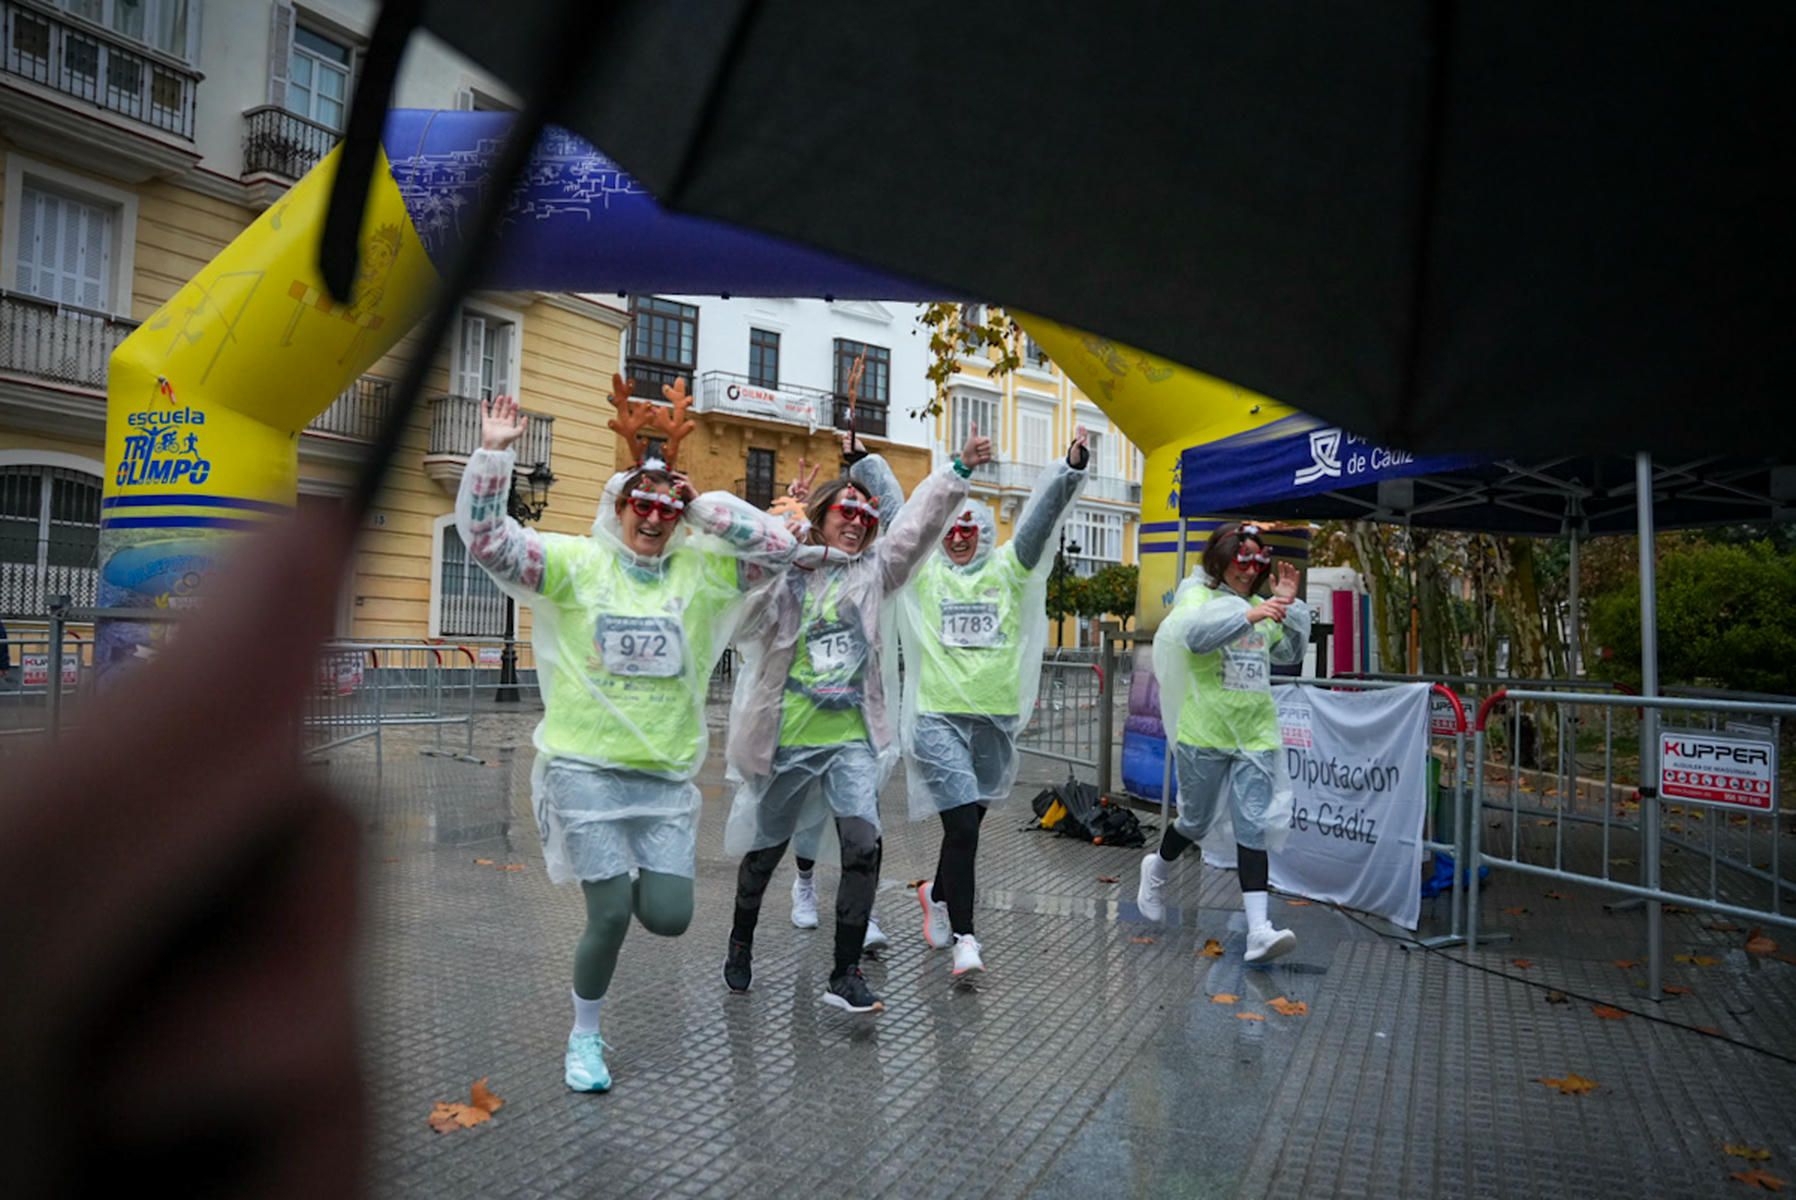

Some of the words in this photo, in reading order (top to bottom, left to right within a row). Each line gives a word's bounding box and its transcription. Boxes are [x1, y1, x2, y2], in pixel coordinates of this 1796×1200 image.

[1347, 451, 1366, 475] de
[949, 616, 993, 633] 1783
[620, 634, 667, 657] 972
[1664, 741, 1768, 766] KUPPER
[1287, 748, 1400, 792] Diputación
[1316, 802, 1378, 845] Cádiz
